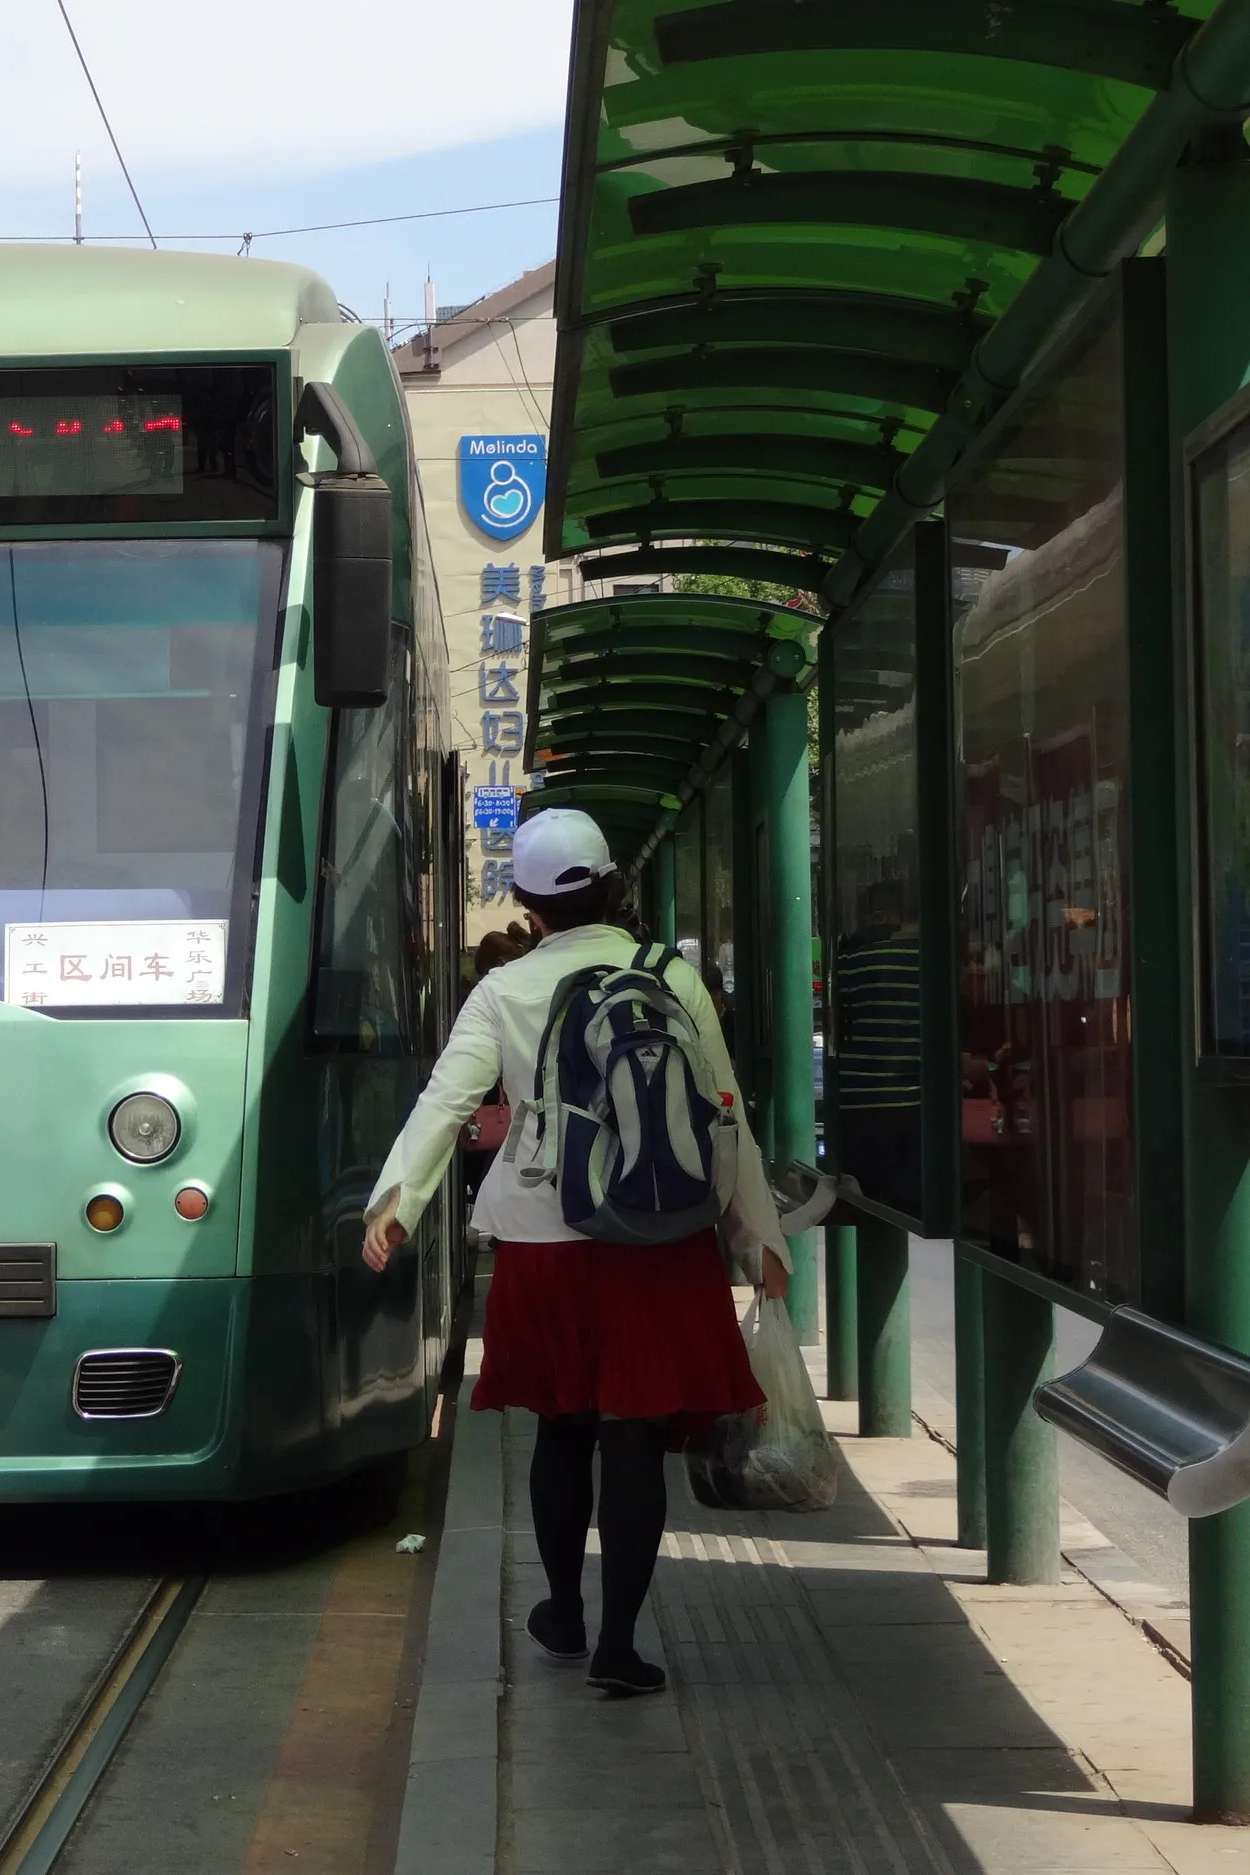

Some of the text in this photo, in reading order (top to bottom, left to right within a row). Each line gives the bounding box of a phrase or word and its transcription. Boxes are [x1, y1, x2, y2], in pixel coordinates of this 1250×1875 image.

[469, 439, 538, 455] Melinda
[21, 932, 49, 1005] 兴工街
[59, 952, 174, 982] 区间车
[185, 929, 213, 1004] 华乐广场
